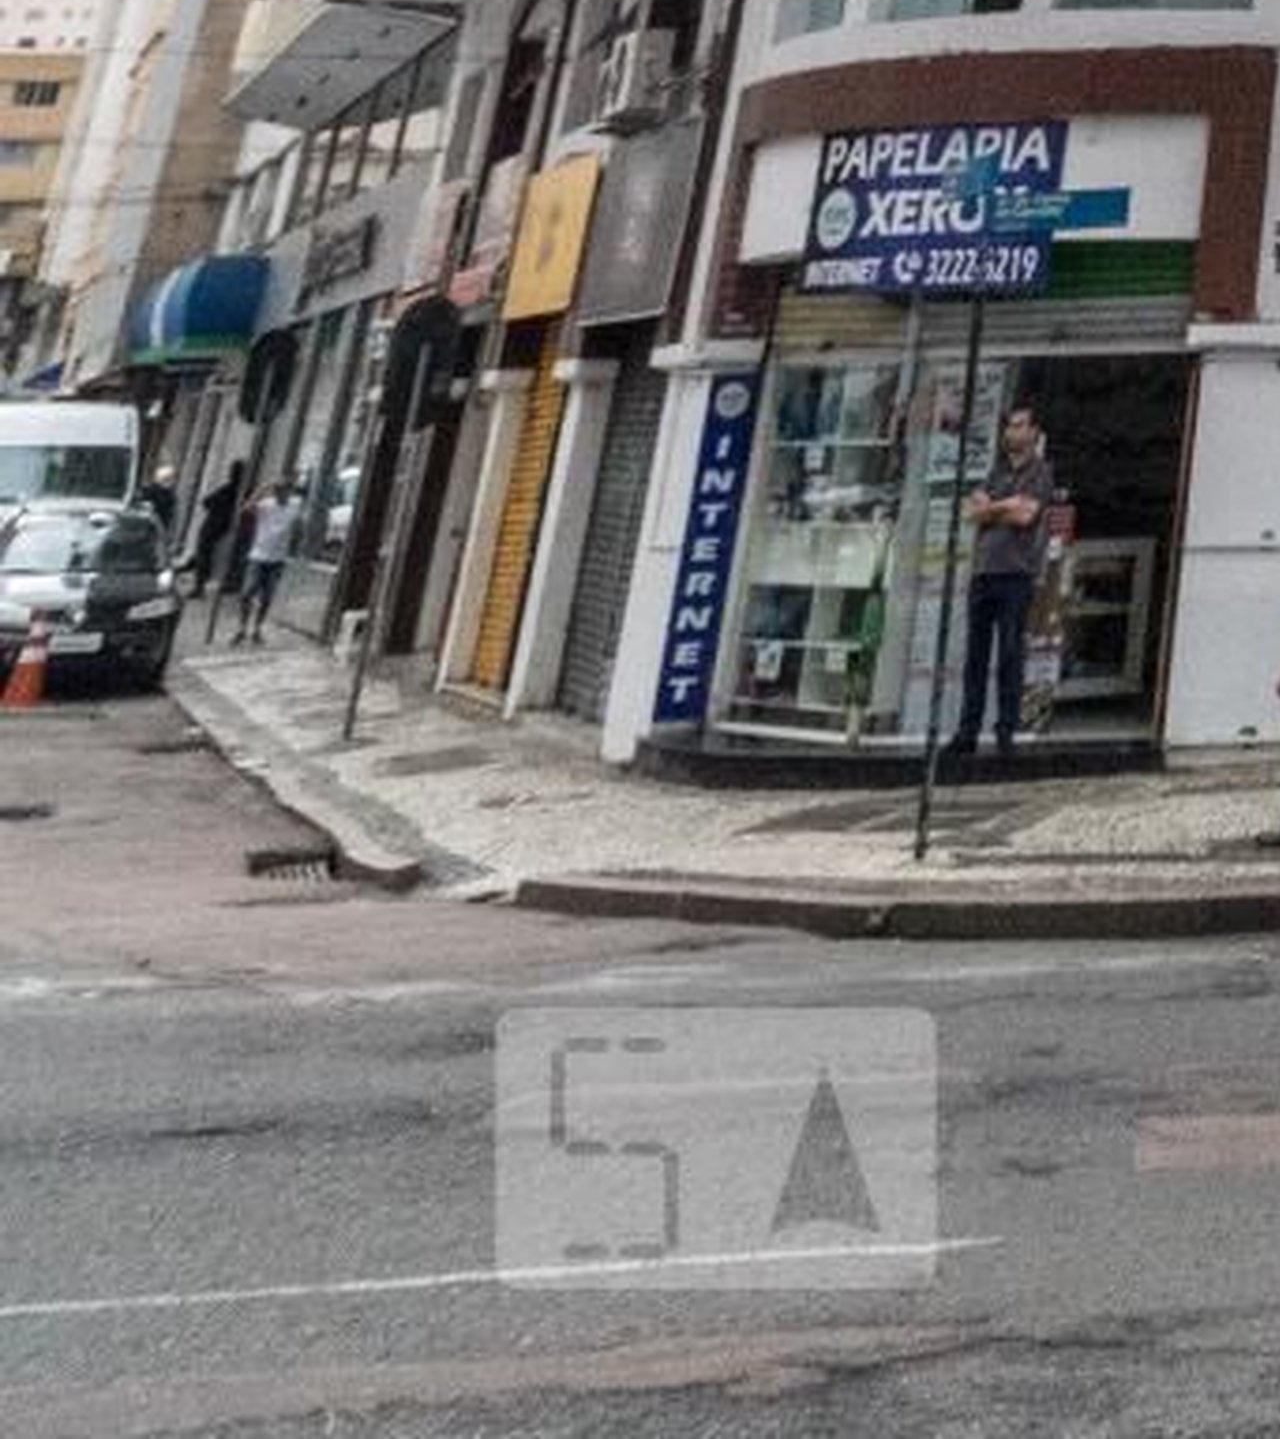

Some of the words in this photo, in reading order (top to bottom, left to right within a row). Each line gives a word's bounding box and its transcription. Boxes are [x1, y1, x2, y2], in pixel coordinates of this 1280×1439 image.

[858, 184, 1031, 238] XERO
[803, 256, 883, 289] INTERNET
[667, 436, 736, 703] INTERNET
